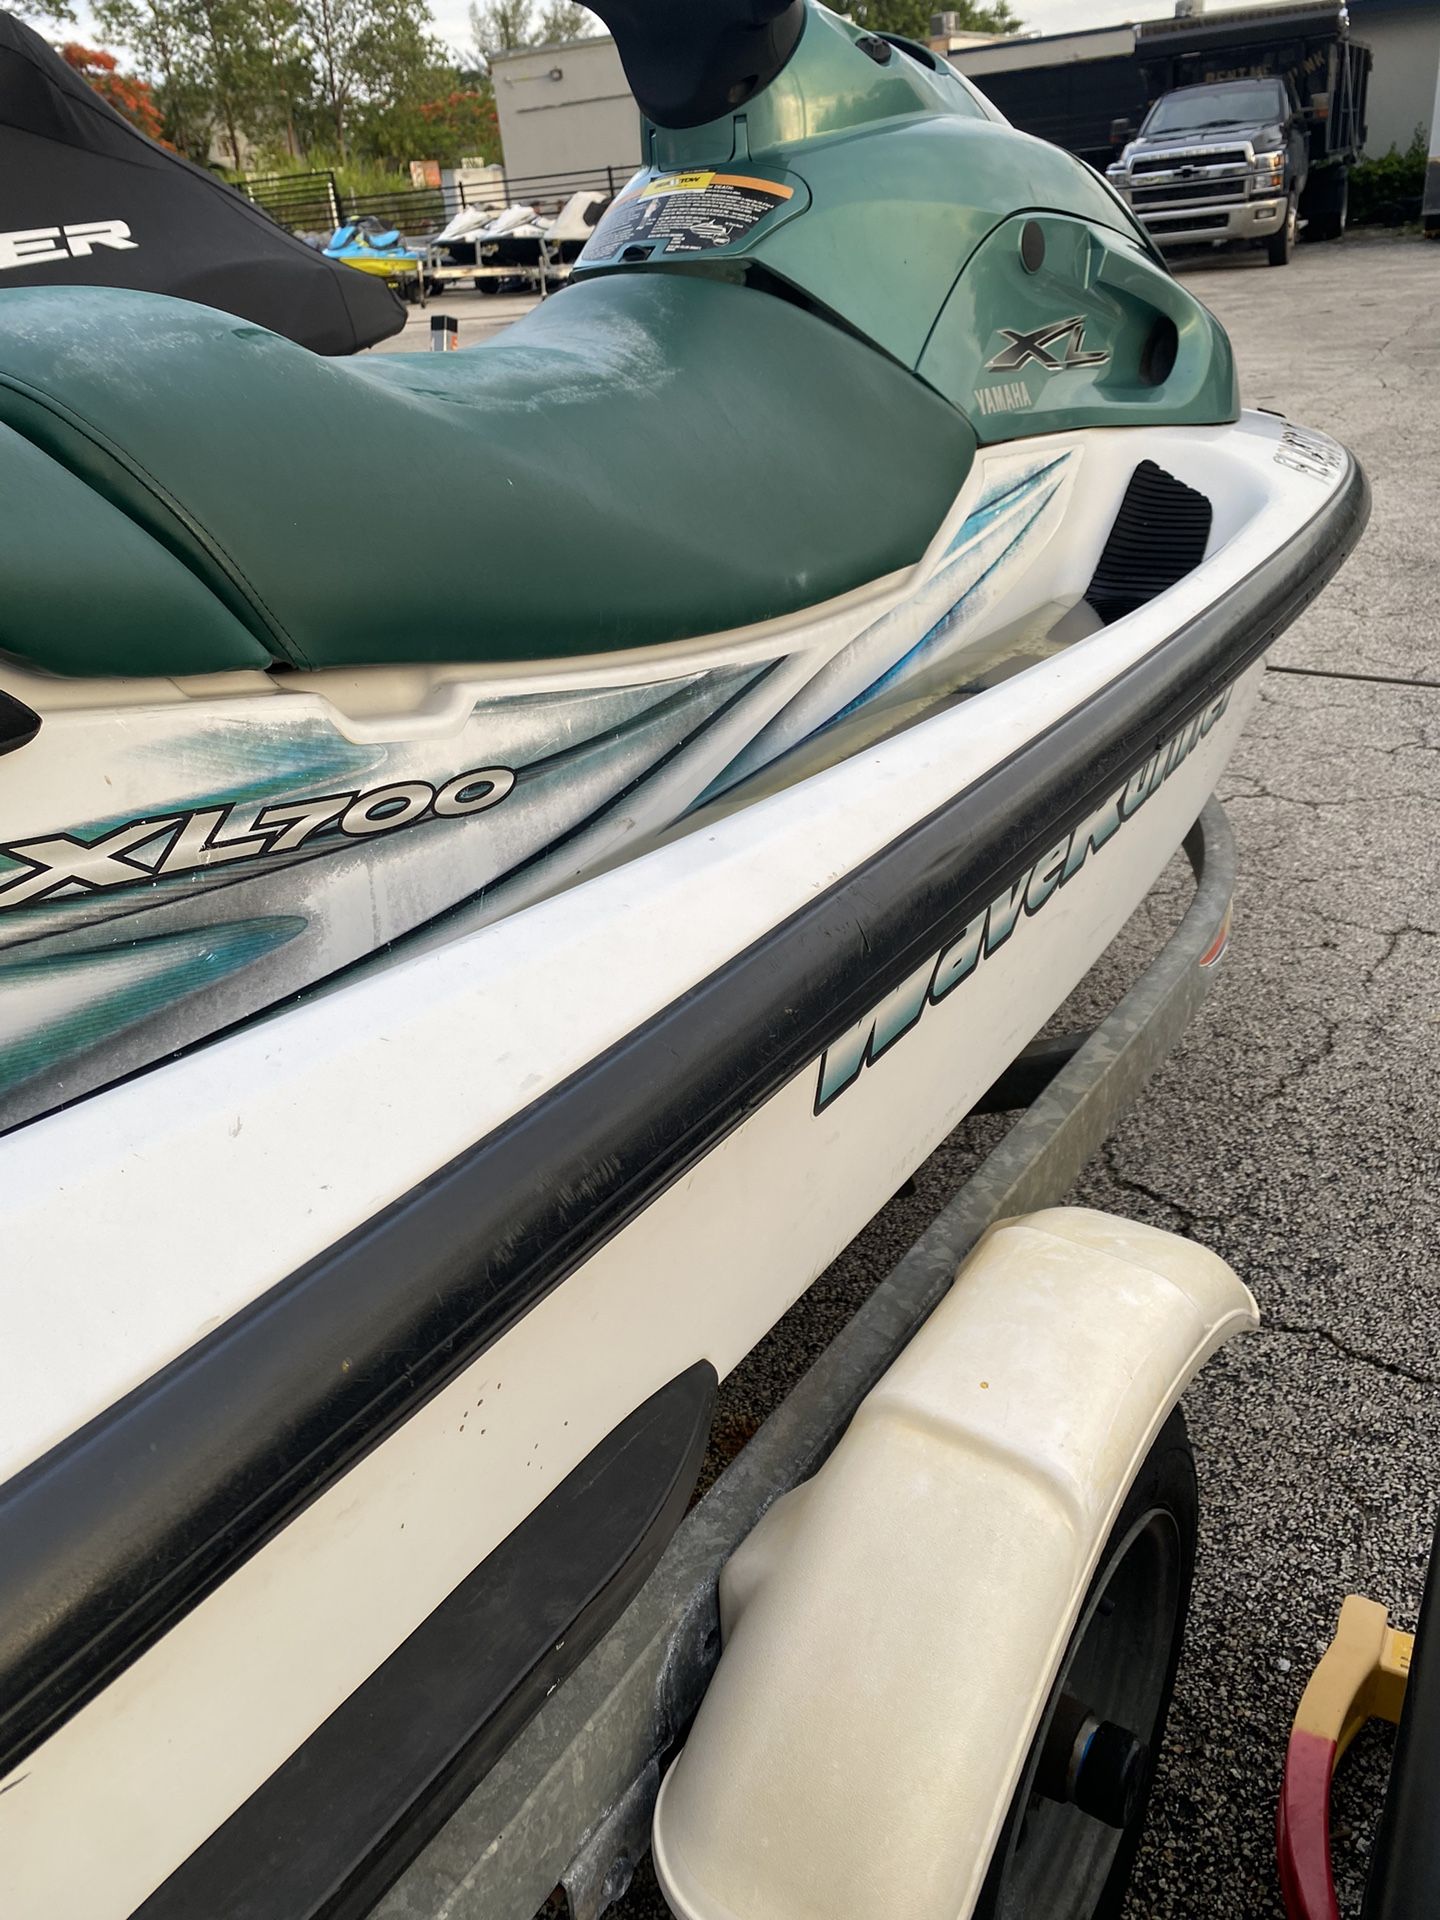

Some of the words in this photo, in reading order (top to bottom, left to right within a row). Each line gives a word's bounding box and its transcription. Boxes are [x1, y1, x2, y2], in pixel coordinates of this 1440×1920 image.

[984, 314, 1111, 374] XL
[974, 381, 1032, 415] YAMAHA
[0, 766, 518, 910] XL700
